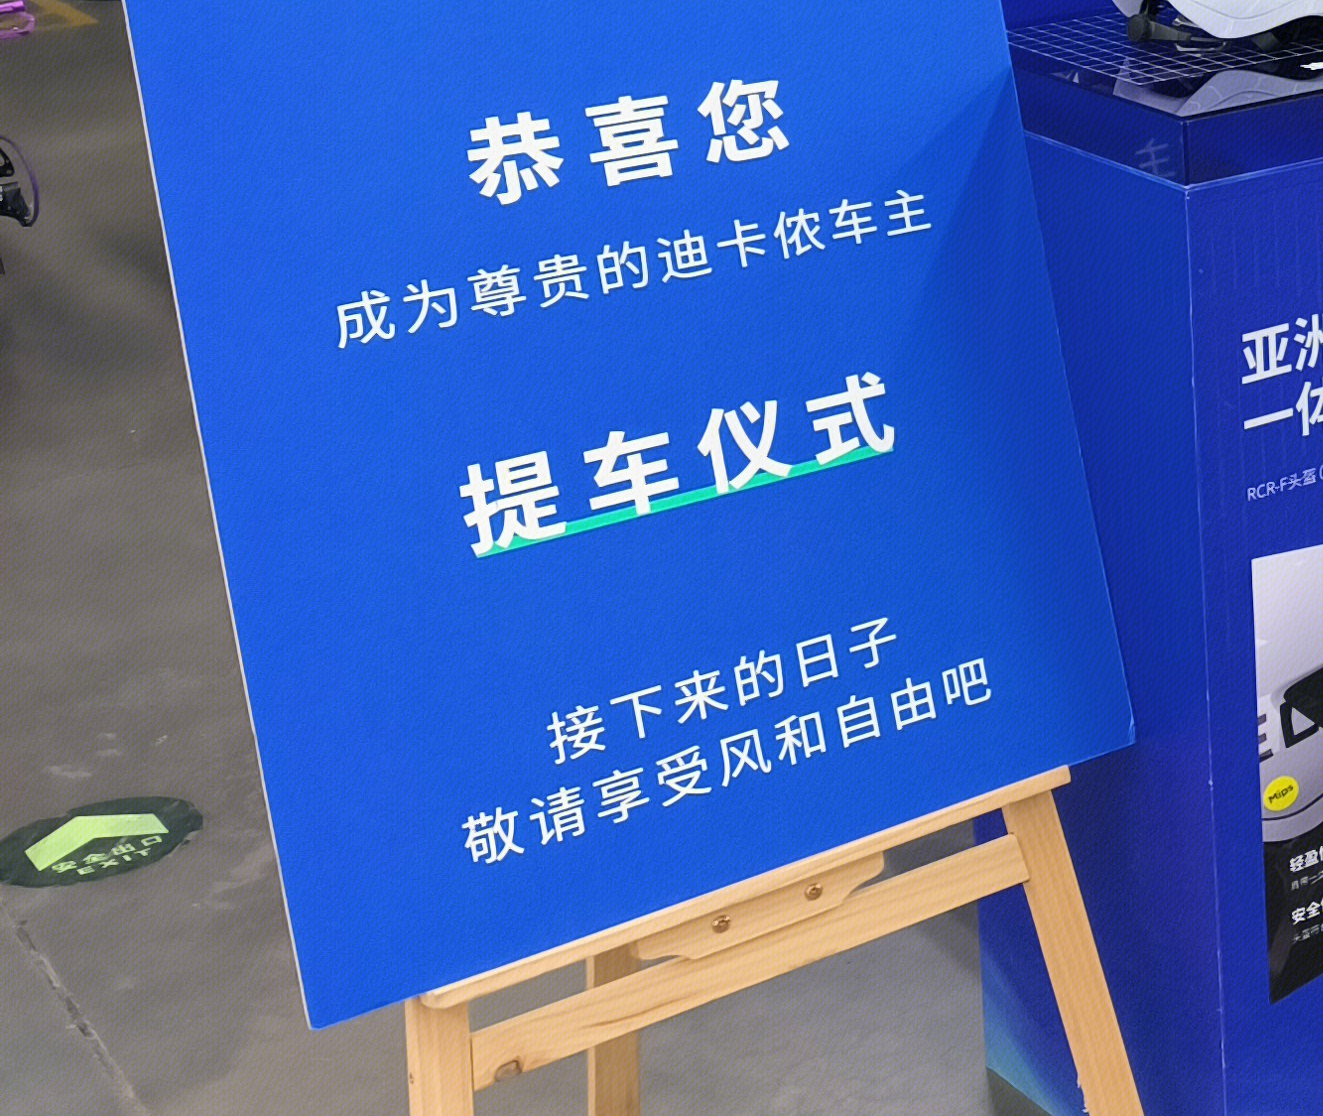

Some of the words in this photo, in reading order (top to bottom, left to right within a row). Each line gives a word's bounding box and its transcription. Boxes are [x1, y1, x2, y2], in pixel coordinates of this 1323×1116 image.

[466, 78, 792, 205] 恭喜您
[334, 188, 934, 350] 成为尊贵的迪卡侬车主
[458, 371, 897, 557] 提车仪式
[461, 658, 994, 866] 敬请享受风和自由吧
[546, 617, 899, 765] 接下来的日子
[1267, 783, 1295, 805] Mips
